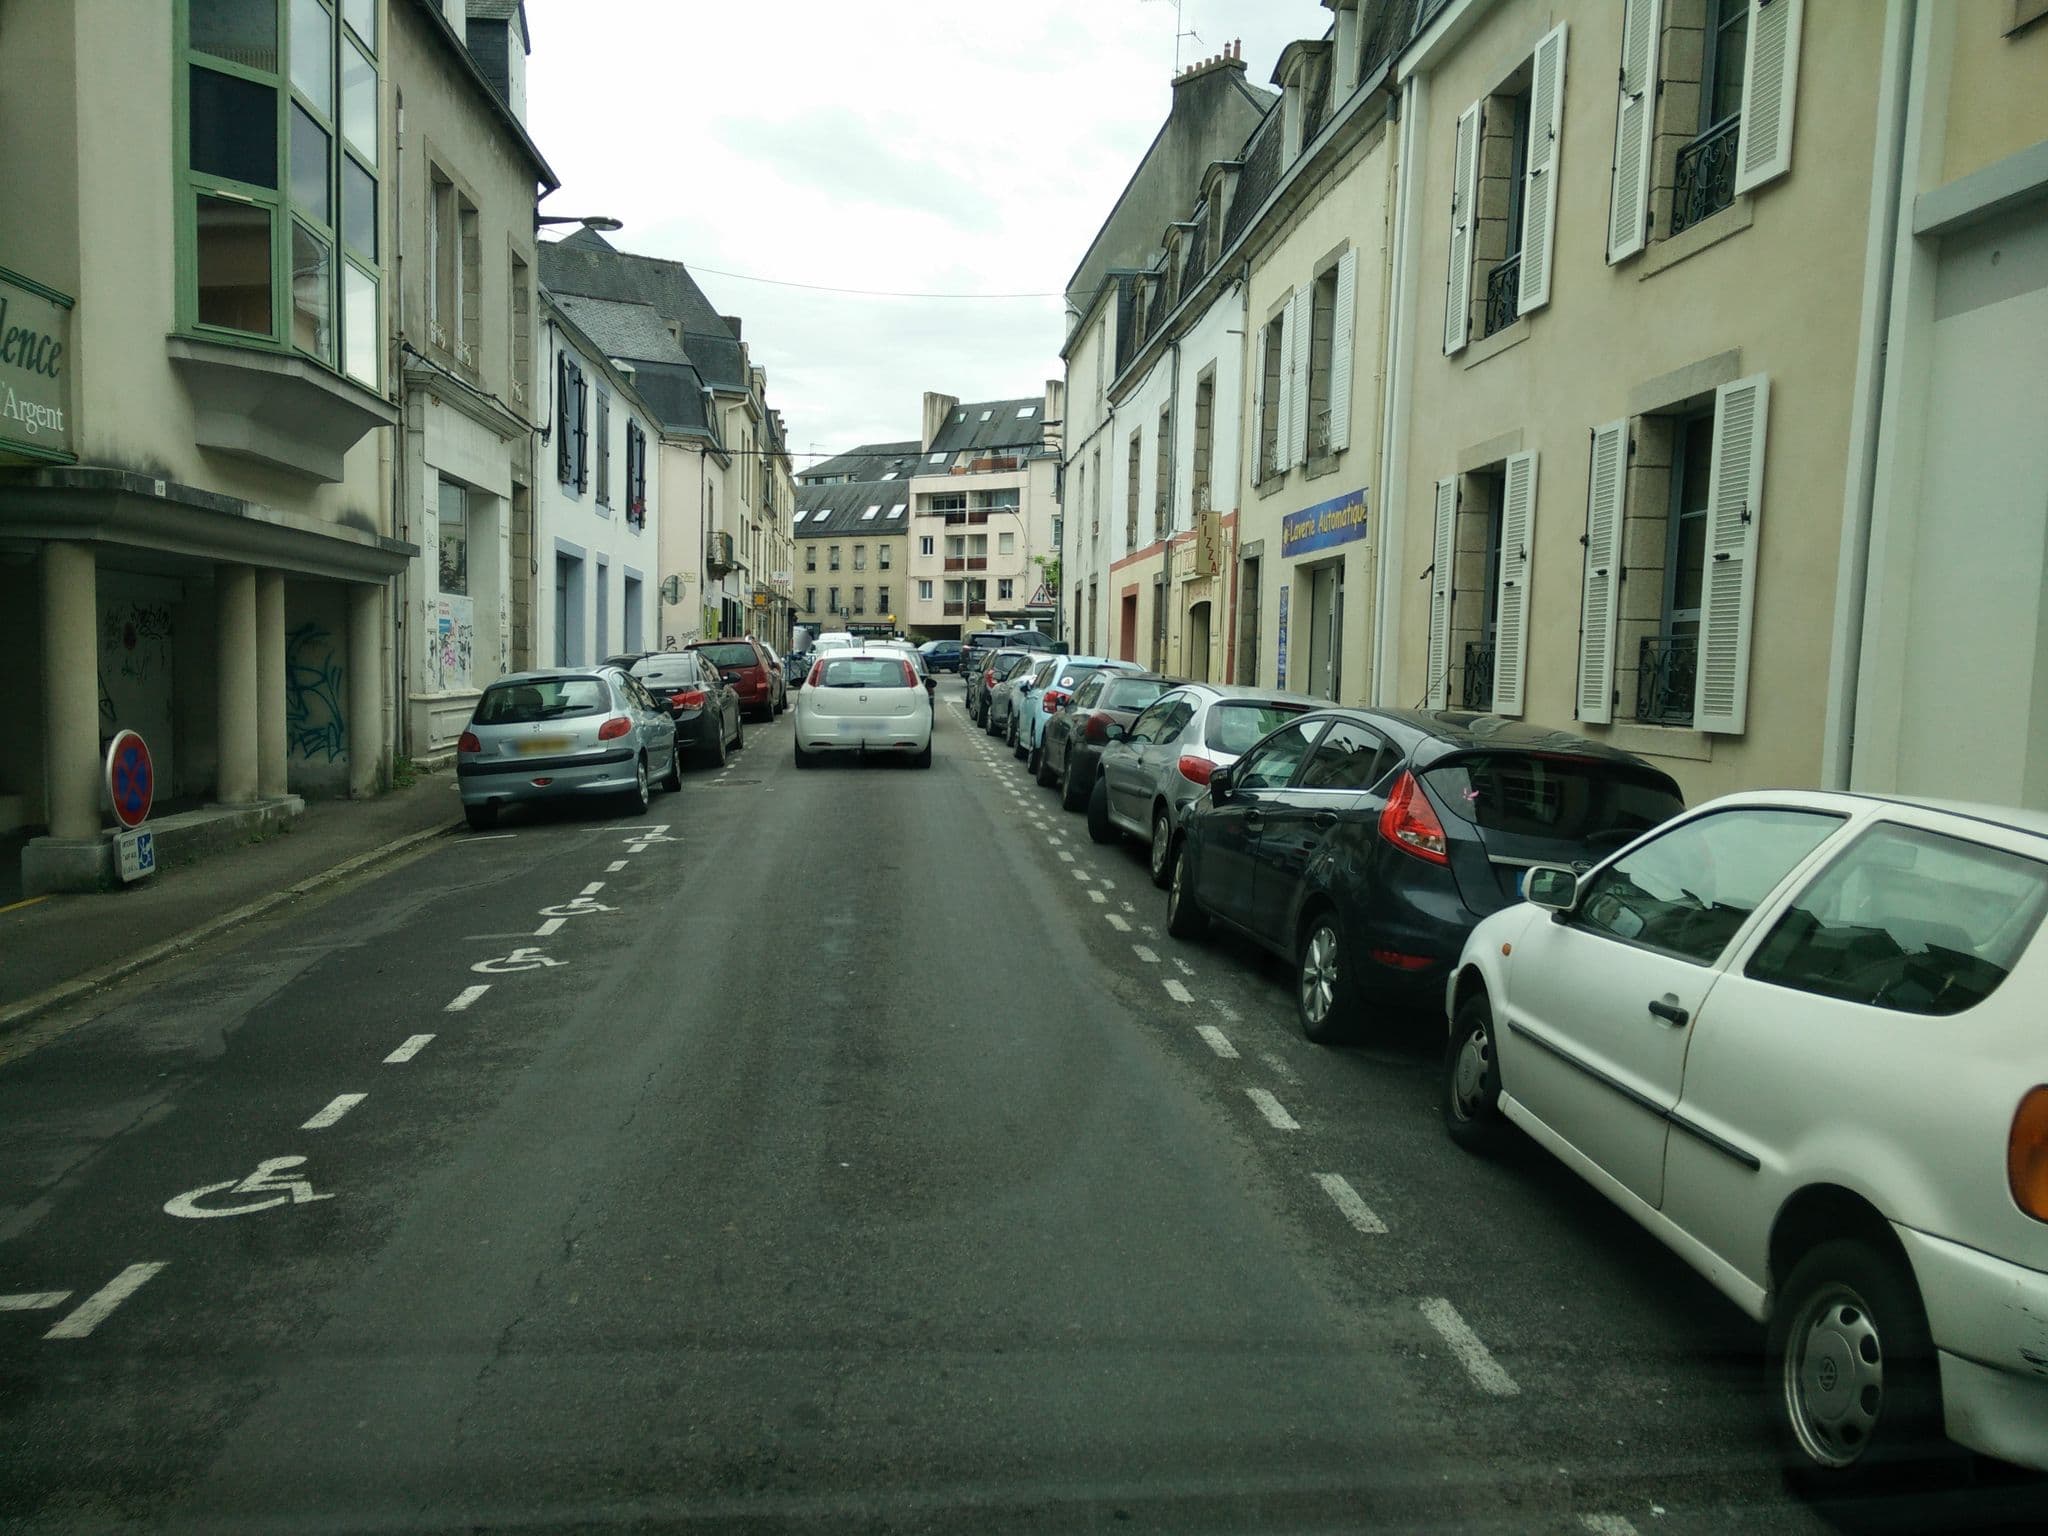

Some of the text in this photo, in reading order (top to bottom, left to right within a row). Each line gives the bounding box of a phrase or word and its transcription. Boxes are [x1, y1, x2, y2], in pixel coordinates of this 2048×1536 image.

[0, 381, 64, 435] 'Argent
[1201, 513, 1217, 573] PIZZA
[1290, 499, 1367, 542] Laverie Automatique
